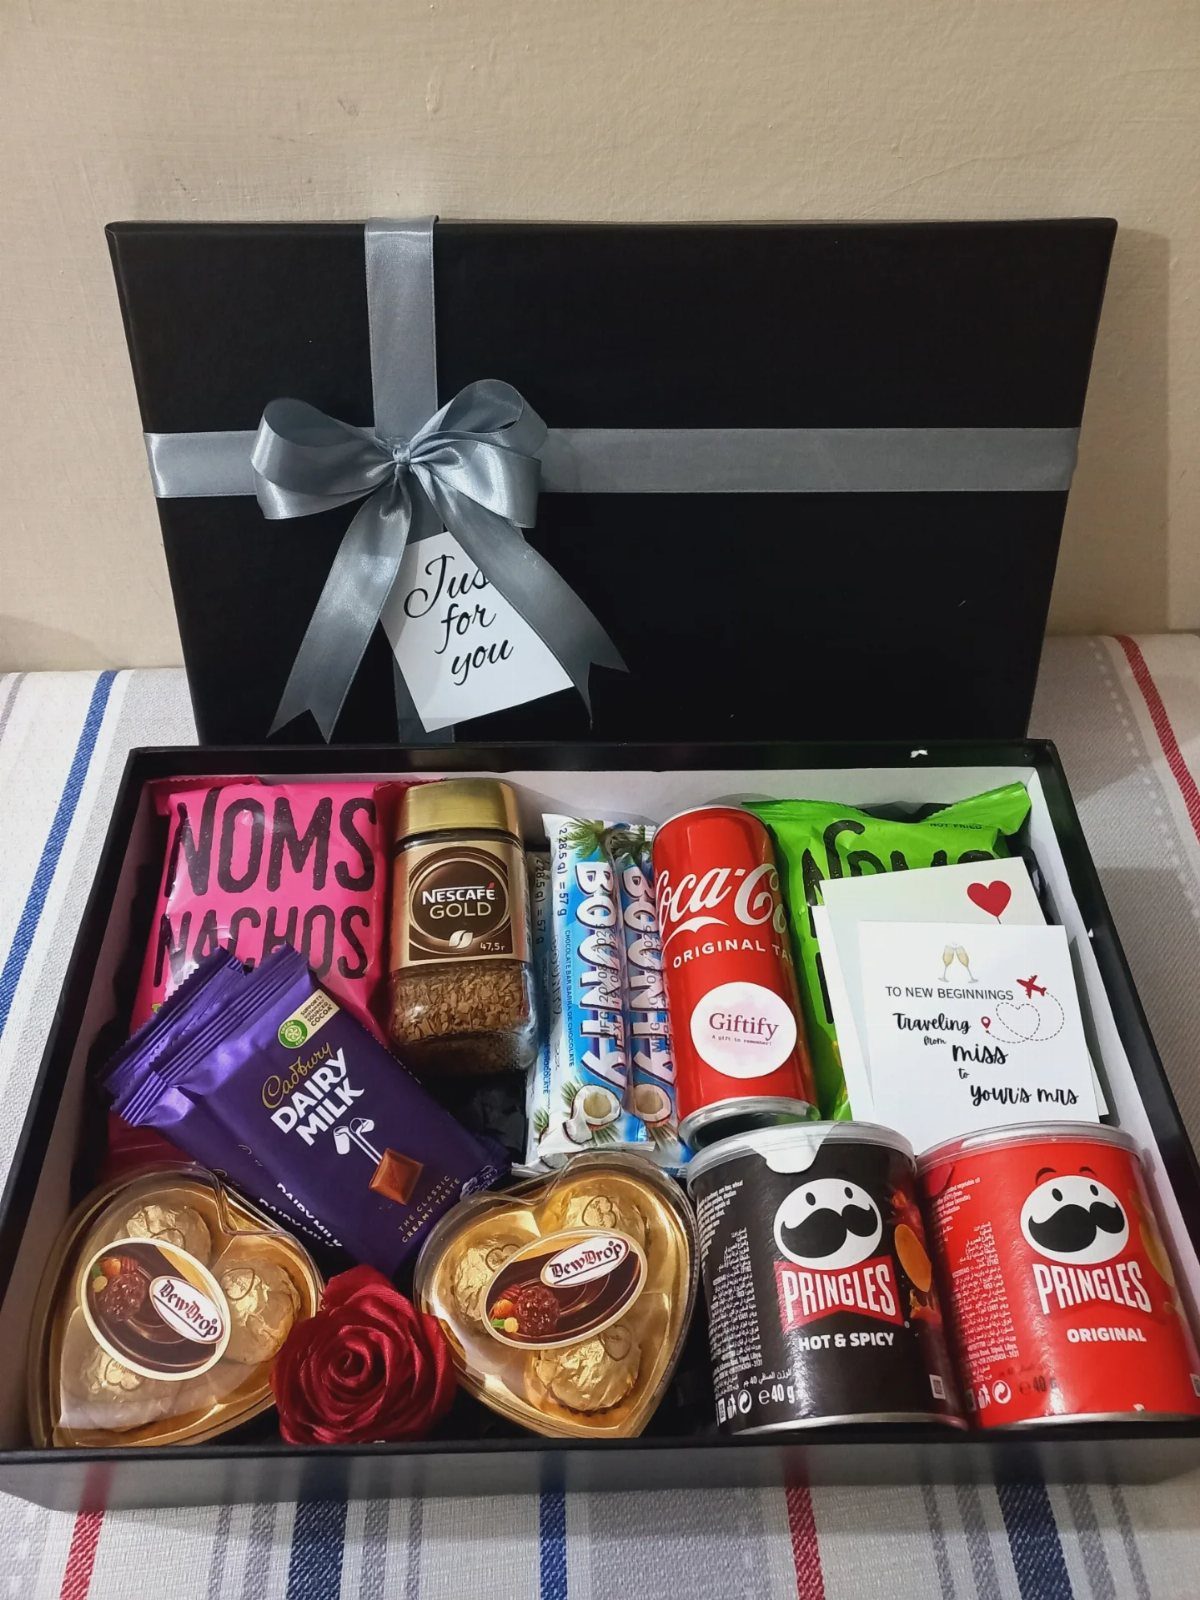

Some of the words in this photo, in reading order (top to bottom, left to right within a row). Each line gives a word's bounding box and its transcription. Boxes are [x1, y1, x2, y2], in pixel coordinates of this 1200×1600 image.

[403, 554, 490, 619] Jus
[434, 603, 497, 654] for
[451, 639, 514, 686] you
[164, 786, 377, 897] NOMS
[429, 902, 492, 920] GOLD
[559, 892, 568, 904] 57
[153, 904, 370, 987] NACHOS
[673, 939, 766, 969] ORIGINAL
[575, 861, 626, 1091] BOUNTY
[885, 986, 902, 997] TO
[905, 987, 933, 998] NEW
[937, 987, 1014, 1001] BEGINNINGS
[708, 1012, 779, 1041] Giftify
[892, 1012, 971, 1035] Traveling
[924, 1035, 947, 1046] from
[262, 1042, 332, 1109] Cadbury
[952, 1044, 1008, 1064] miss
[958, 1067, 970, 1079] to
[270, 1047, 349, 1135] DAIRY
[295, 1078, 365, 1146] MILK
[1036, 1087, 1079, 1106] mrs
[398, 1214, 416, 1232] THE
[416, 1175, 451, 1213] CLASSIC
[401, 1207, 434, 1244] CREAMY
[434, 1178, 461, 1206] TASTE
[549, 1240, 623, 1279] DewDrop
[159, 1279, 218, 1339] DewDrop
[781, 1264, 896, 1325] PRINGLES
[1032, 1260, 1152, 1316] PRINGLES
[800, 1333, 832, 1351] HOT
[834, 1333, 846, 1348] &
[850, 1332, 894, 1347] SPICY
[1067, 1327, 1147, 1343] ORIGINAL
[771, 1384, 785, 1402] 40
